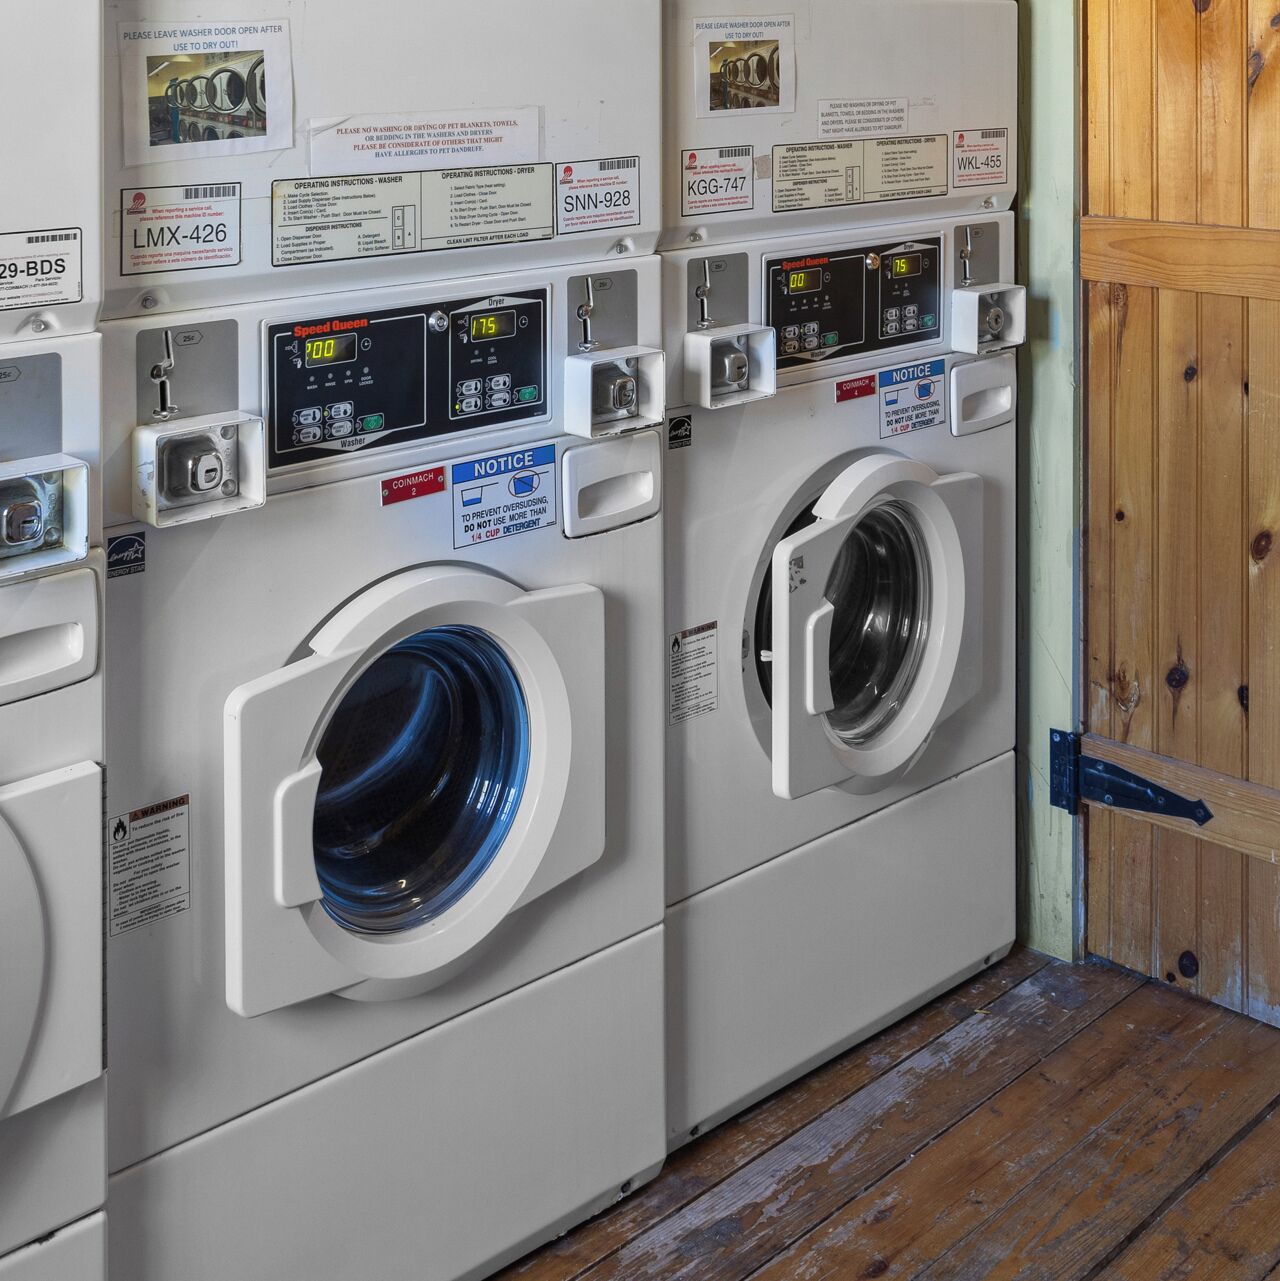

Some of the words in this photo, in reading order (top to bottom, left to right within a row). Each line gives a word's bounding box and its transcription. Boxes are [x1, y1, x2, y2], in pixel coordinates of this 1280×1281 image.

[124, 31, 152, 40] PLEASE
[154, 30, 178, 39] LEAVE
[179, 28, 213, 38] WASHER
[214, 27, 236, 36] DOOR
[238, 26, 258, 35] OPEN
[260, 25, 282, 33] AFTER
[173, 43, 188, 52] USE
[190, 42, 201, 51] TO
[202, 42, 218, 50] DRY
[219, 40, 238, 49] OUT!
[958, 155, 1001, 170] WKL-455
[688, 176, 746, 196] KGG-747
[564, 190, 630, 212] SNN-928
[134, 223, 226, 248] LMX-426
[782, 260, 805, 270] Speed
[806, 257, 829, 267] Queen
[489, 298, 504, 306] Dryer
[294, 322, 330, 338] Speed
[332, 319, 368, 331] Queen
[473, 318, 495, 335] 175
[893, 365, 930, 382] NOTICE
[843, 380, 869, 390] COINMACH
[340, 437, 365, 448] Washer
[475, 452, 534, 477] NOTICE
[392, 472, 434, 489] COINMACH
[462, 514, 470, 522] TO
[472, 506, 501, 520] PREVENT
[503, 496, 548, 513] OVERSUDSING,
[464, 524, 474, 533] DO
[477, 519, 491, 530] NOT
[494, 516, 506, 526] USE
[509, 511, 527, 522] MORE
[529, 507, 546, 517] THAN
[471, 533, 481, 542] 1/4
[485, 528, 500, 538] CUP
[503, 518, 540, 534] DETERGENT
[141, 797, 185, 818] WARNING
